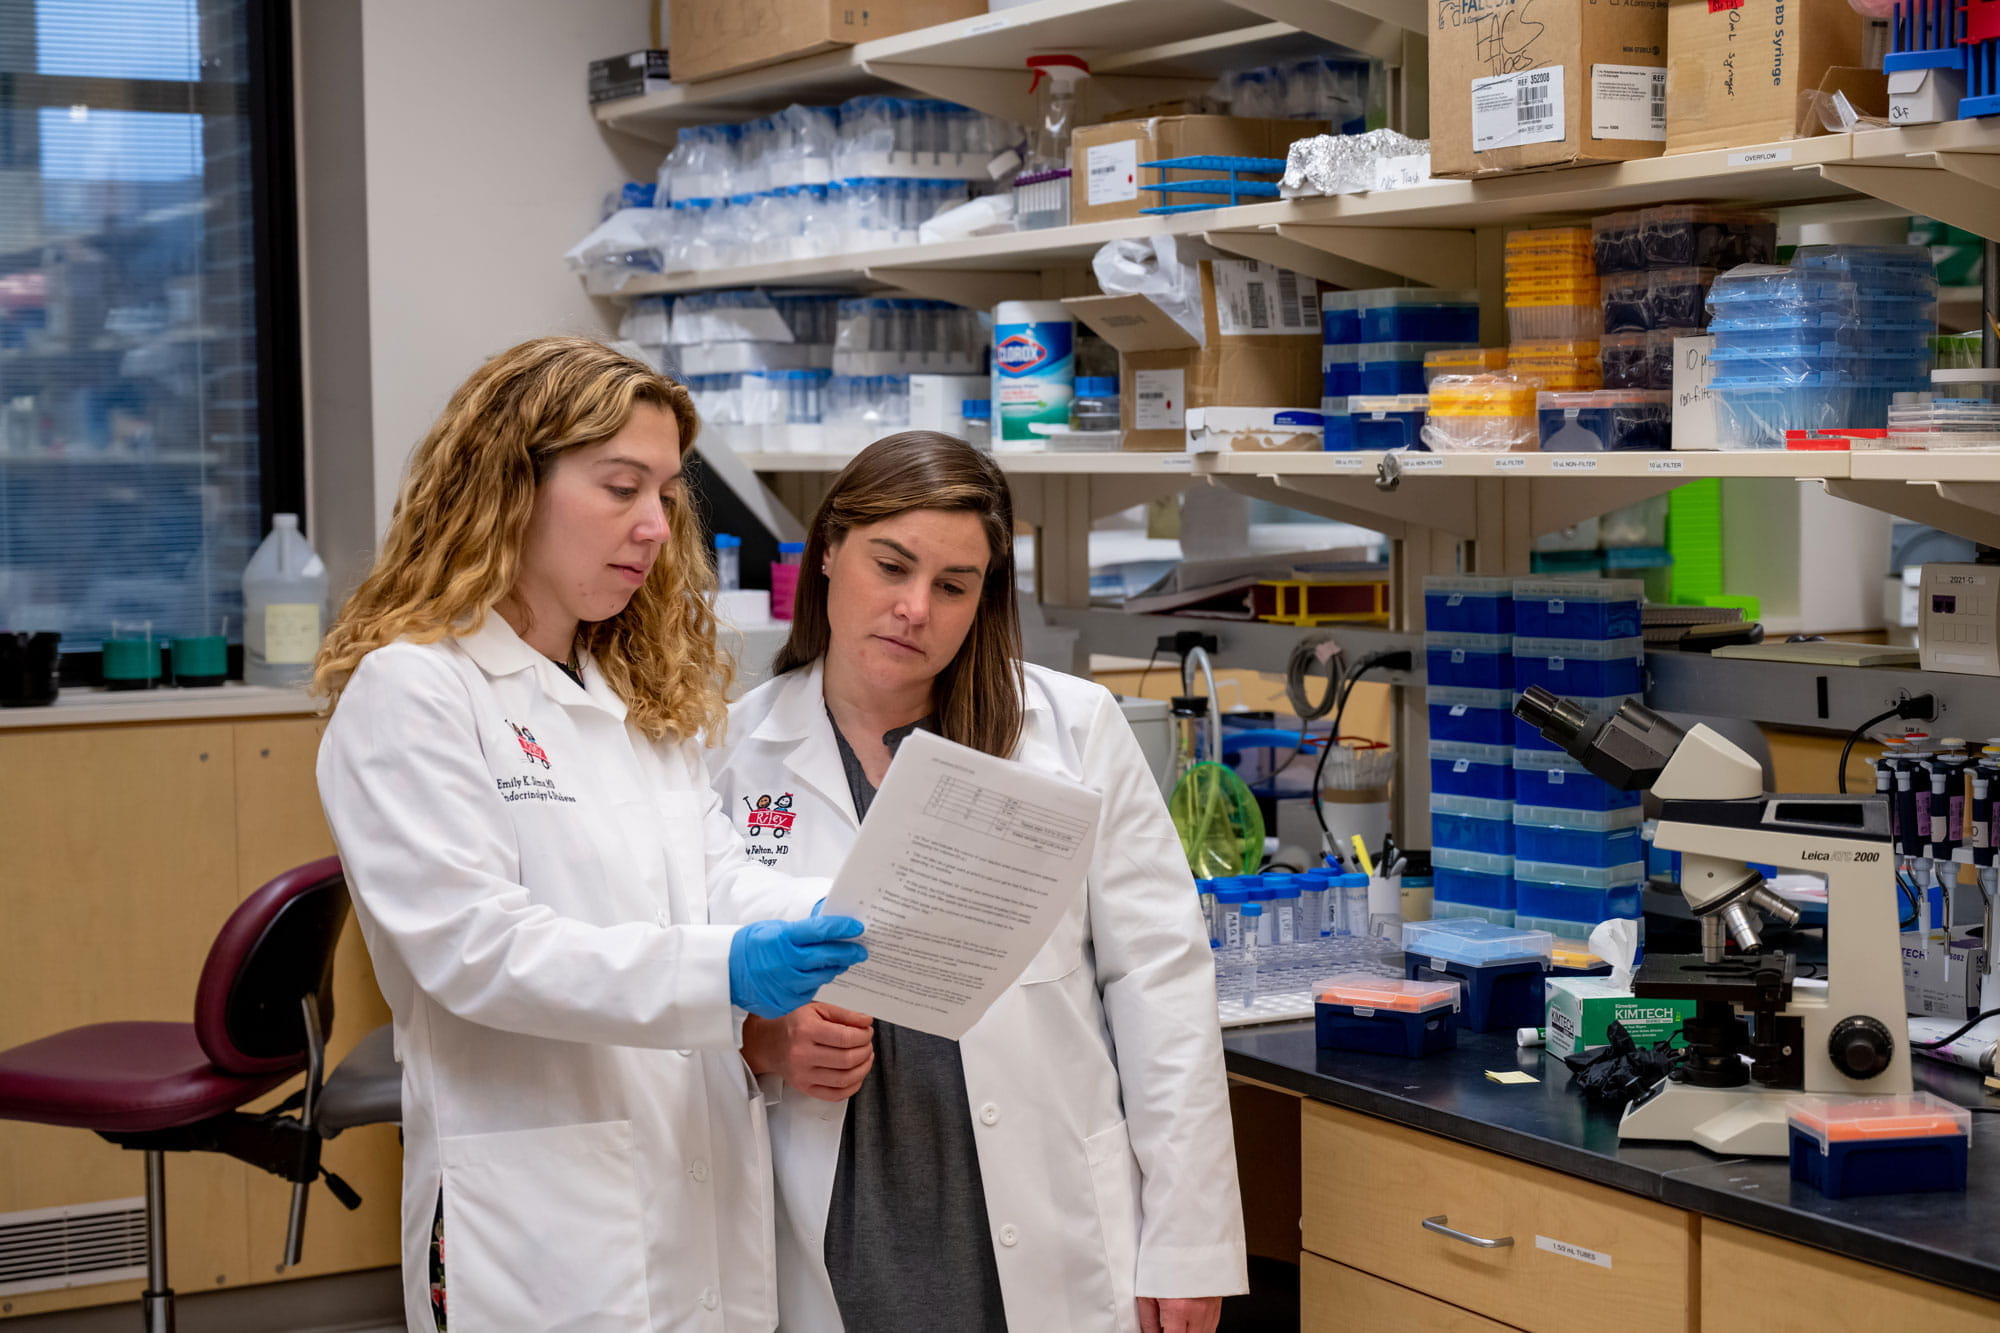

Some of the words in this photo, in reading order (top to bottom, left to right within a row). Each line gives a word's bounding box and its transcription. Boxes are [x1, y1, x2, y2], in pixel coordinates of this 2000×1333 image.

[1775, 4, 1785, 26] BD
[1772, 29, 1785, 87] Syringe
[1530, 72, 1550, 85] 352008
[1652, 74, 1665, 83] REF
[1744, 152, 1777, 162] OVERFLOW
[496, 776, 522, 790] Emily
[756, 812, 788, 827] Riley
[775, 844, 789, 855] MD
[1801, 850, 1830, 861] Leica
[1853, 851, 1880, 862] 2000
[1615, 1007, 1674, 1020] KIMTECH
[1551, 1010, 1575, 1035] KIMTECH
